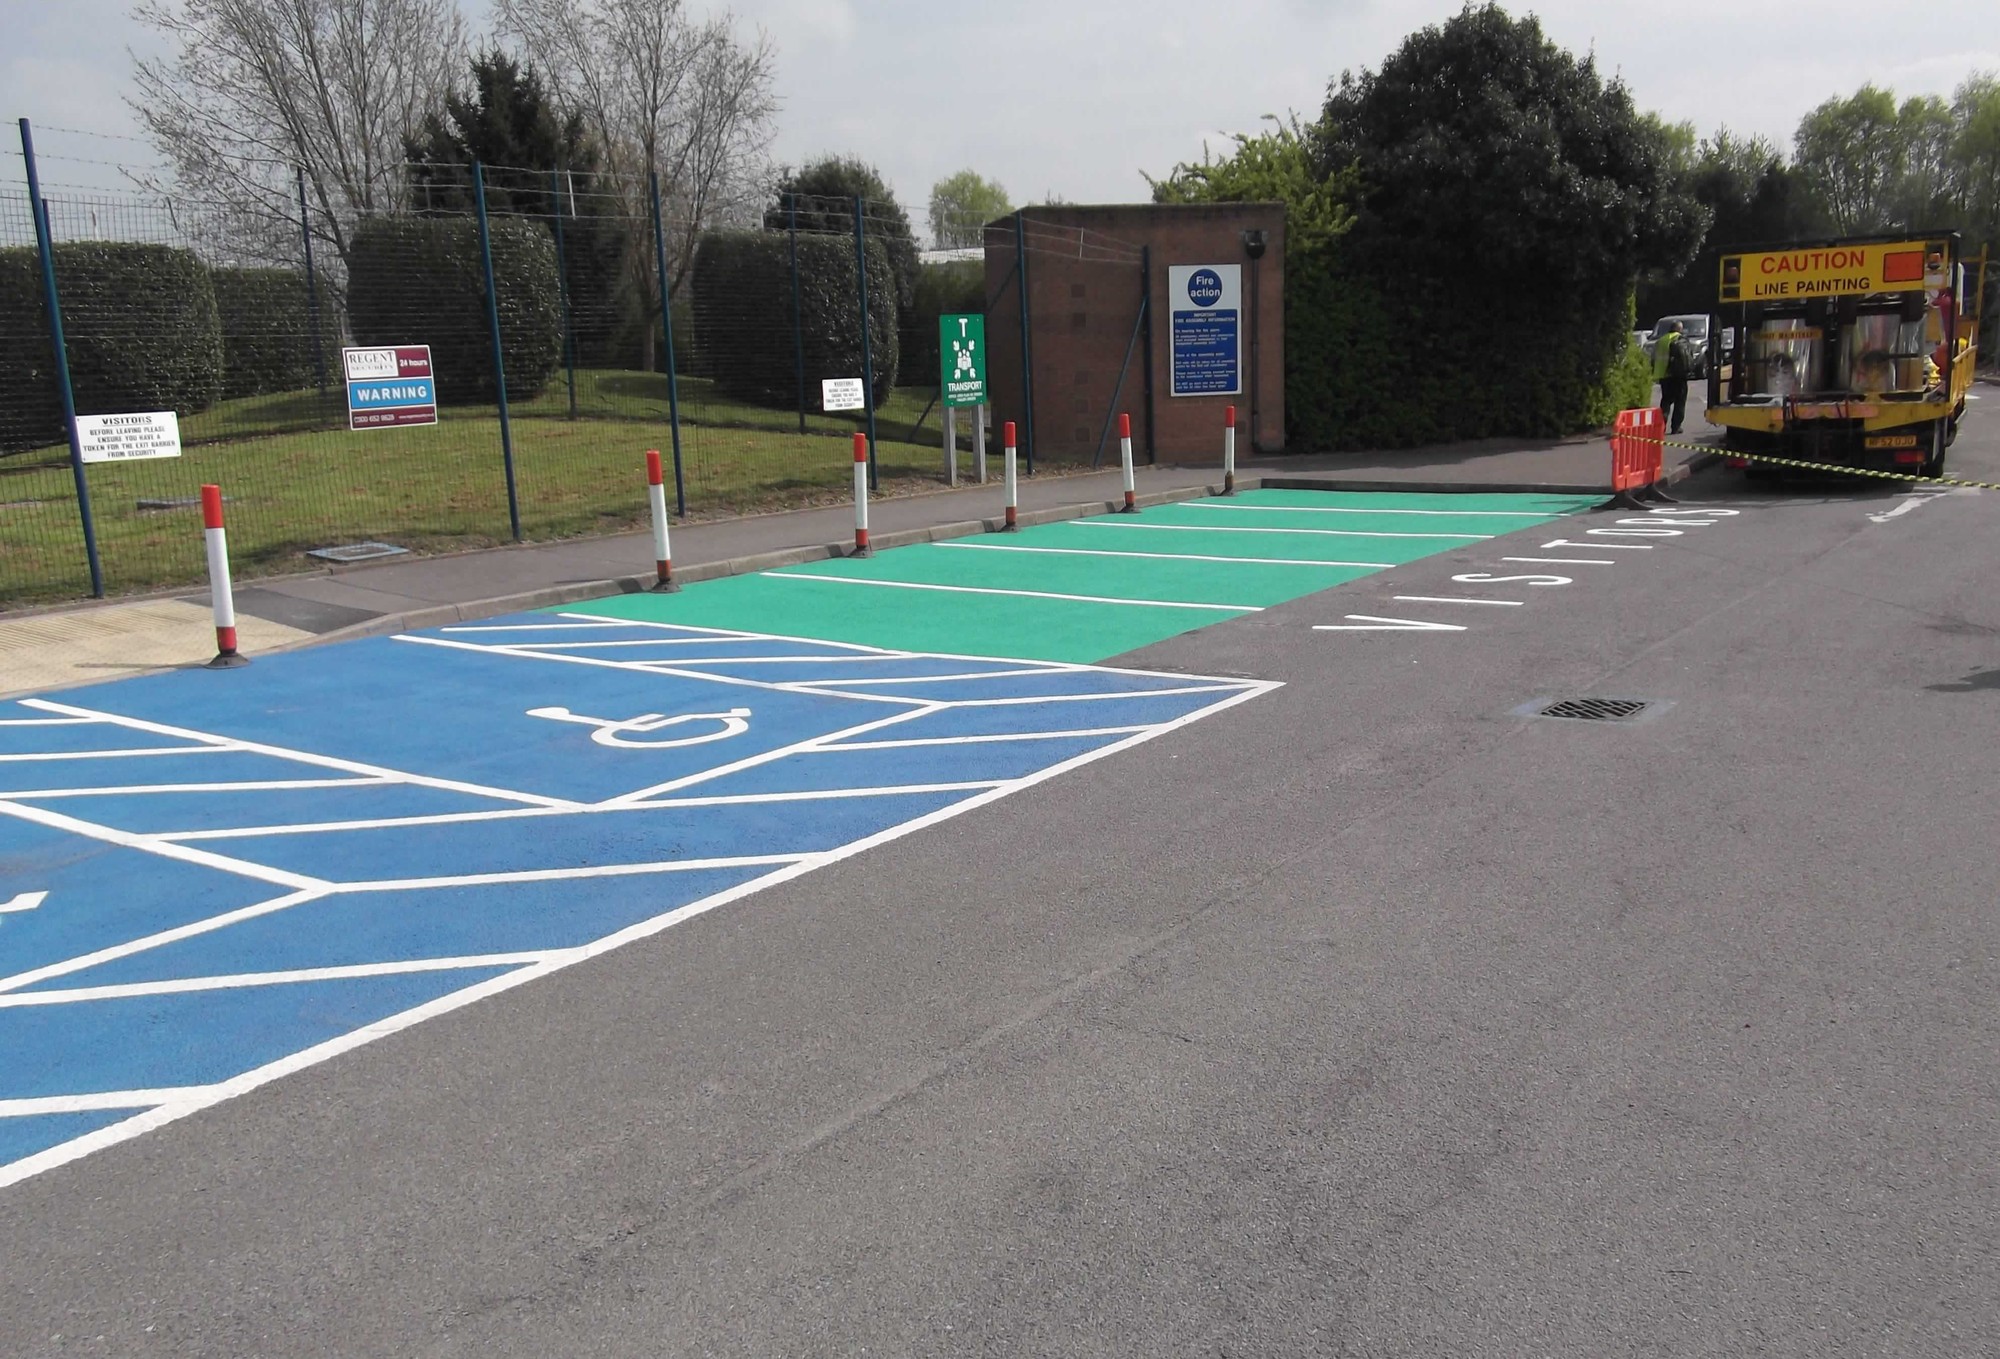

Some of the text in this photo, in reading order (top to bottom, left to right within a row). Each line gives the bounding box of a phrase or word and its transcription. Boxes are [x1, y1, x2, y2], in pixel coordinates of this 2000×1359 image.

[1760, 249, 1865, 274] CAUTION
[1196, 275, 1214, 286] Fire
[1755, 277, 1870, 296] LINE PAINTING
[1190, 287, 1220, 297] action
[958, 318, 968, 337] T
[349, 352, 393, 364] REGENT
[399, 359, 428, 367] 24 hours
[947, 380, 983, 392] TRANSPORT
[357, 385, 427, 402] WARNING
[102, 416, 152, 424] VISITORS
[116, 427, 141, 435] LEAVING
[128, 449, 156, 457] SECURITY
[1312, 507, 1740, 631] VISITORS
